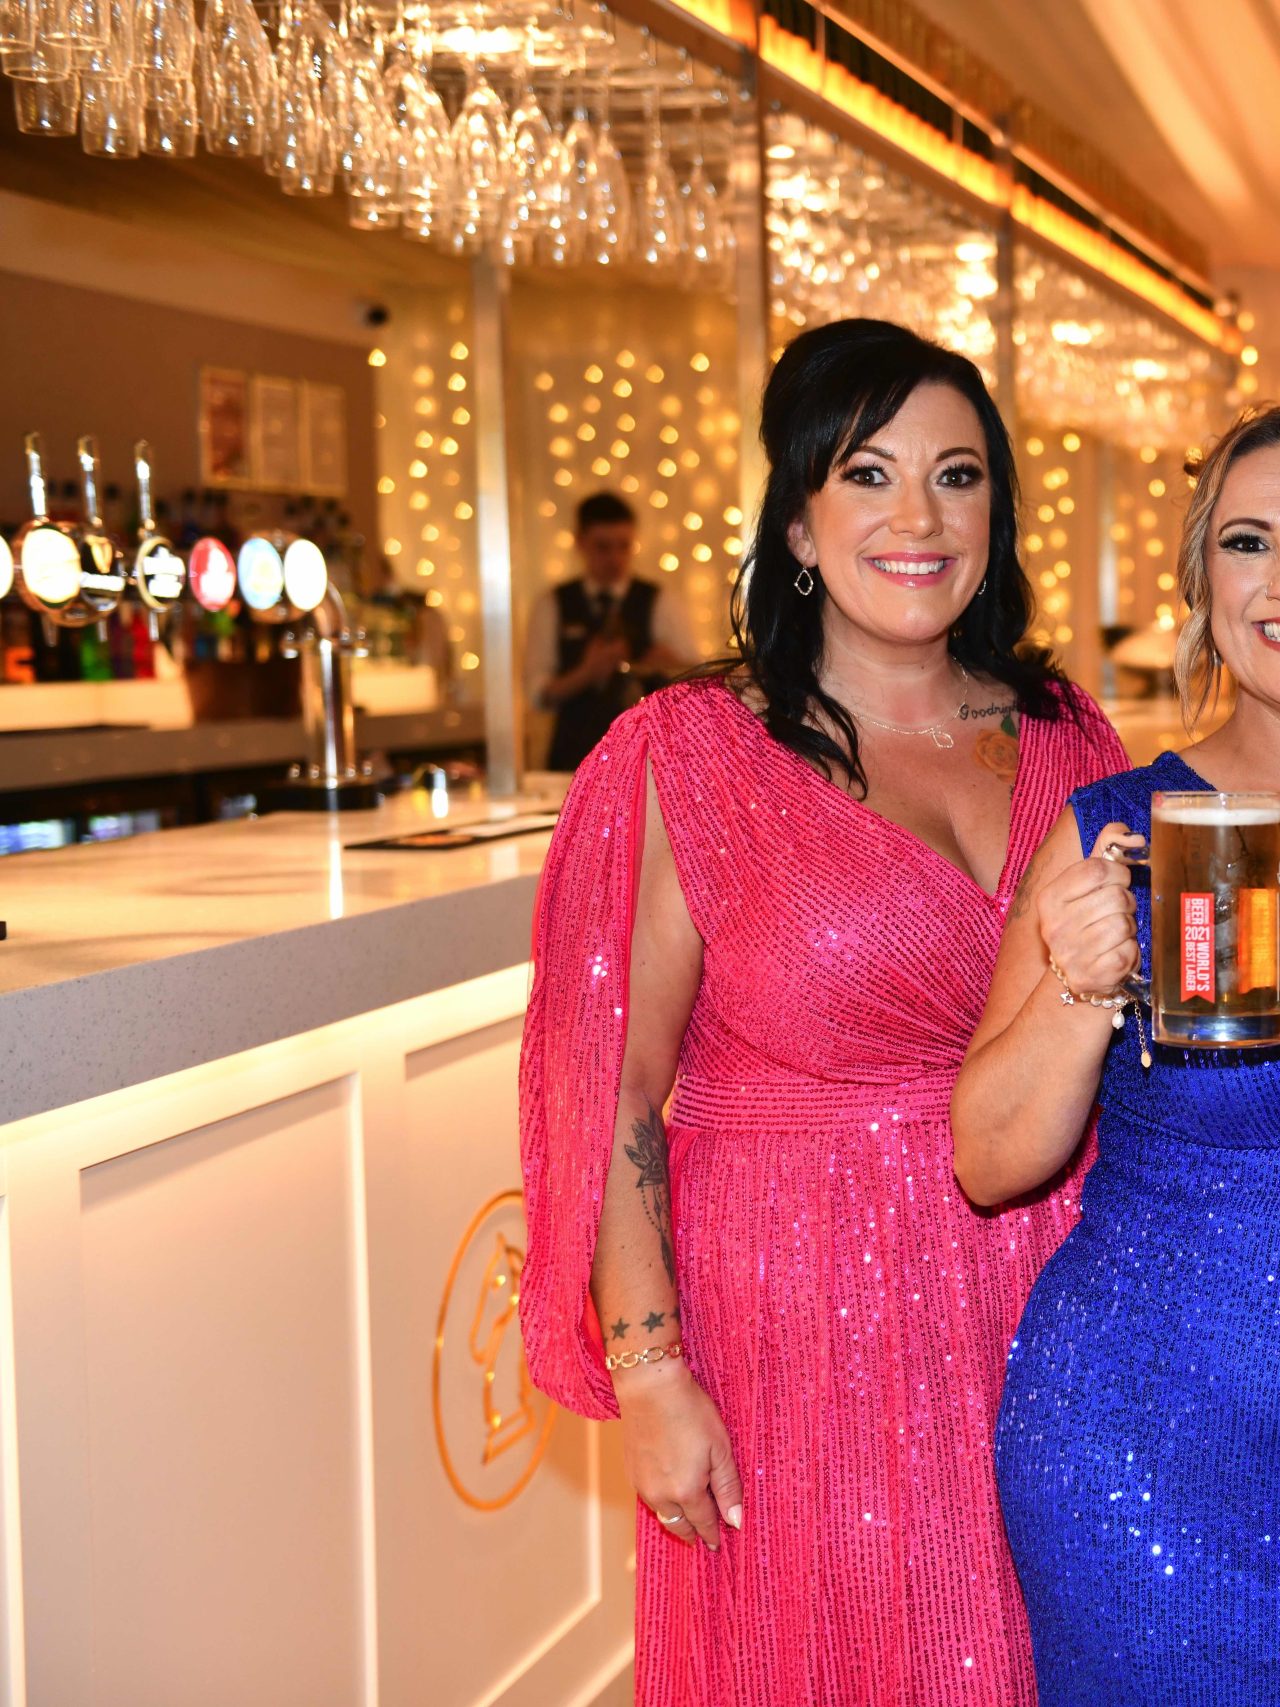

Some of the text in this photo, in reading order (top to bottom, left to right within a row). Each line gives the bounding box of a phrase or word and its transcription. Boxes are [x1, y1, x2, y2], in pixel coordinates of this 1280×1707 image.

[960, 700, 1020, 720] Goodnigh
[1191, 898, 1204, 925] BEER
[1185, 926, 1210, 941] 2021
[1186, 941, 1196, 991] BEST LAGER
[1197, 941, 1210, 991] WORLD'S
